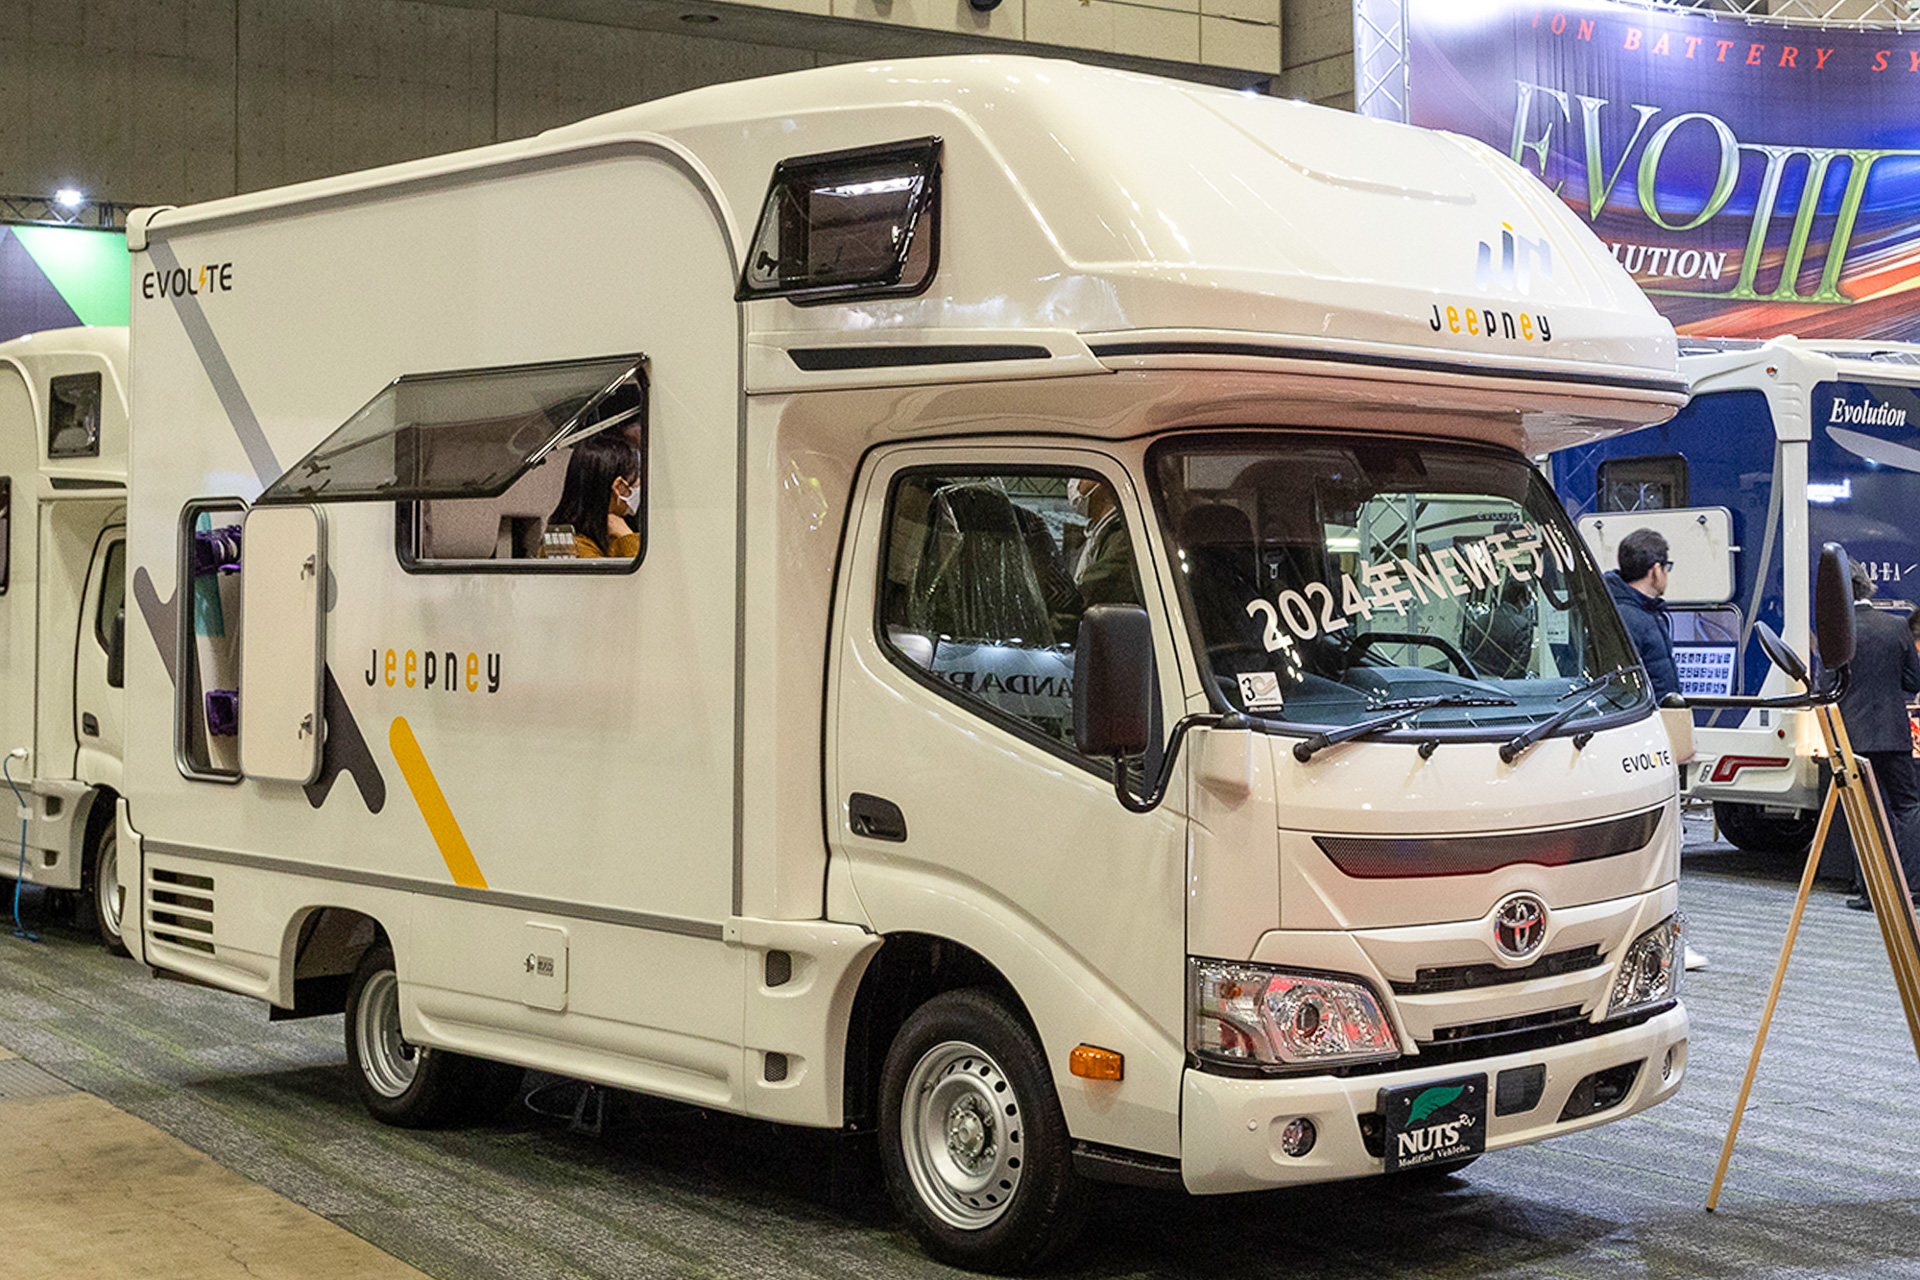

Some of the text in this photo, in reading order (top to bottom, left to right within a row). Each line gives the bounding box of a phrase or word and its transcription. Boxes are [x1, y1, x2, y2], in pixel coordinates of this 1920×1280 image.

[1623, 27, 1834, 70] BATTERY
[1829, 397, 1907, 427] Evolution
[1397, 1121, 1461, 1157] NUTS
[1399, 1151, 1435, 1168] Modified
